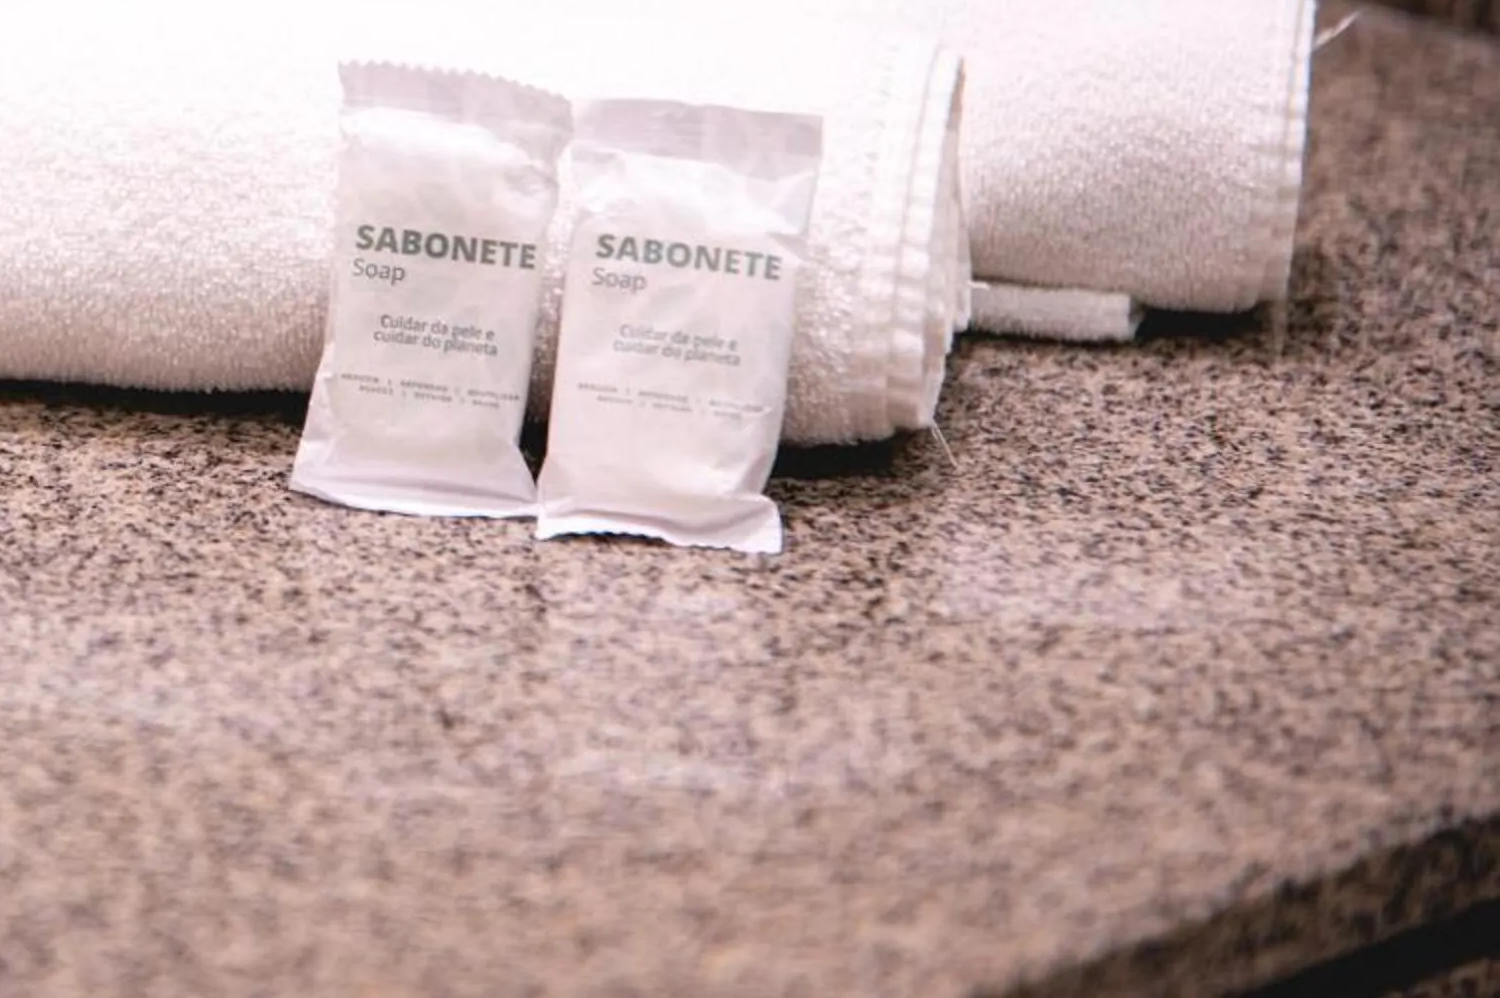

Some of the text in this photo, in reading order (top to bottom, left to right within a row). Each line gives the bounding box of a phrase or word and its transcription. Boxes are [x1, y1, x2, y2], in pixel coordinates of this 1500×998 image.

[355, 224, 537, 270] SABONETE
[595, 233, 783, 281] SABONETE
[352, 257, 406, 286] Soap
[591, 266, 647, 294] Soap
[380, 314, 428, 333] Cuidar
[485, 330, 495, 341] e
